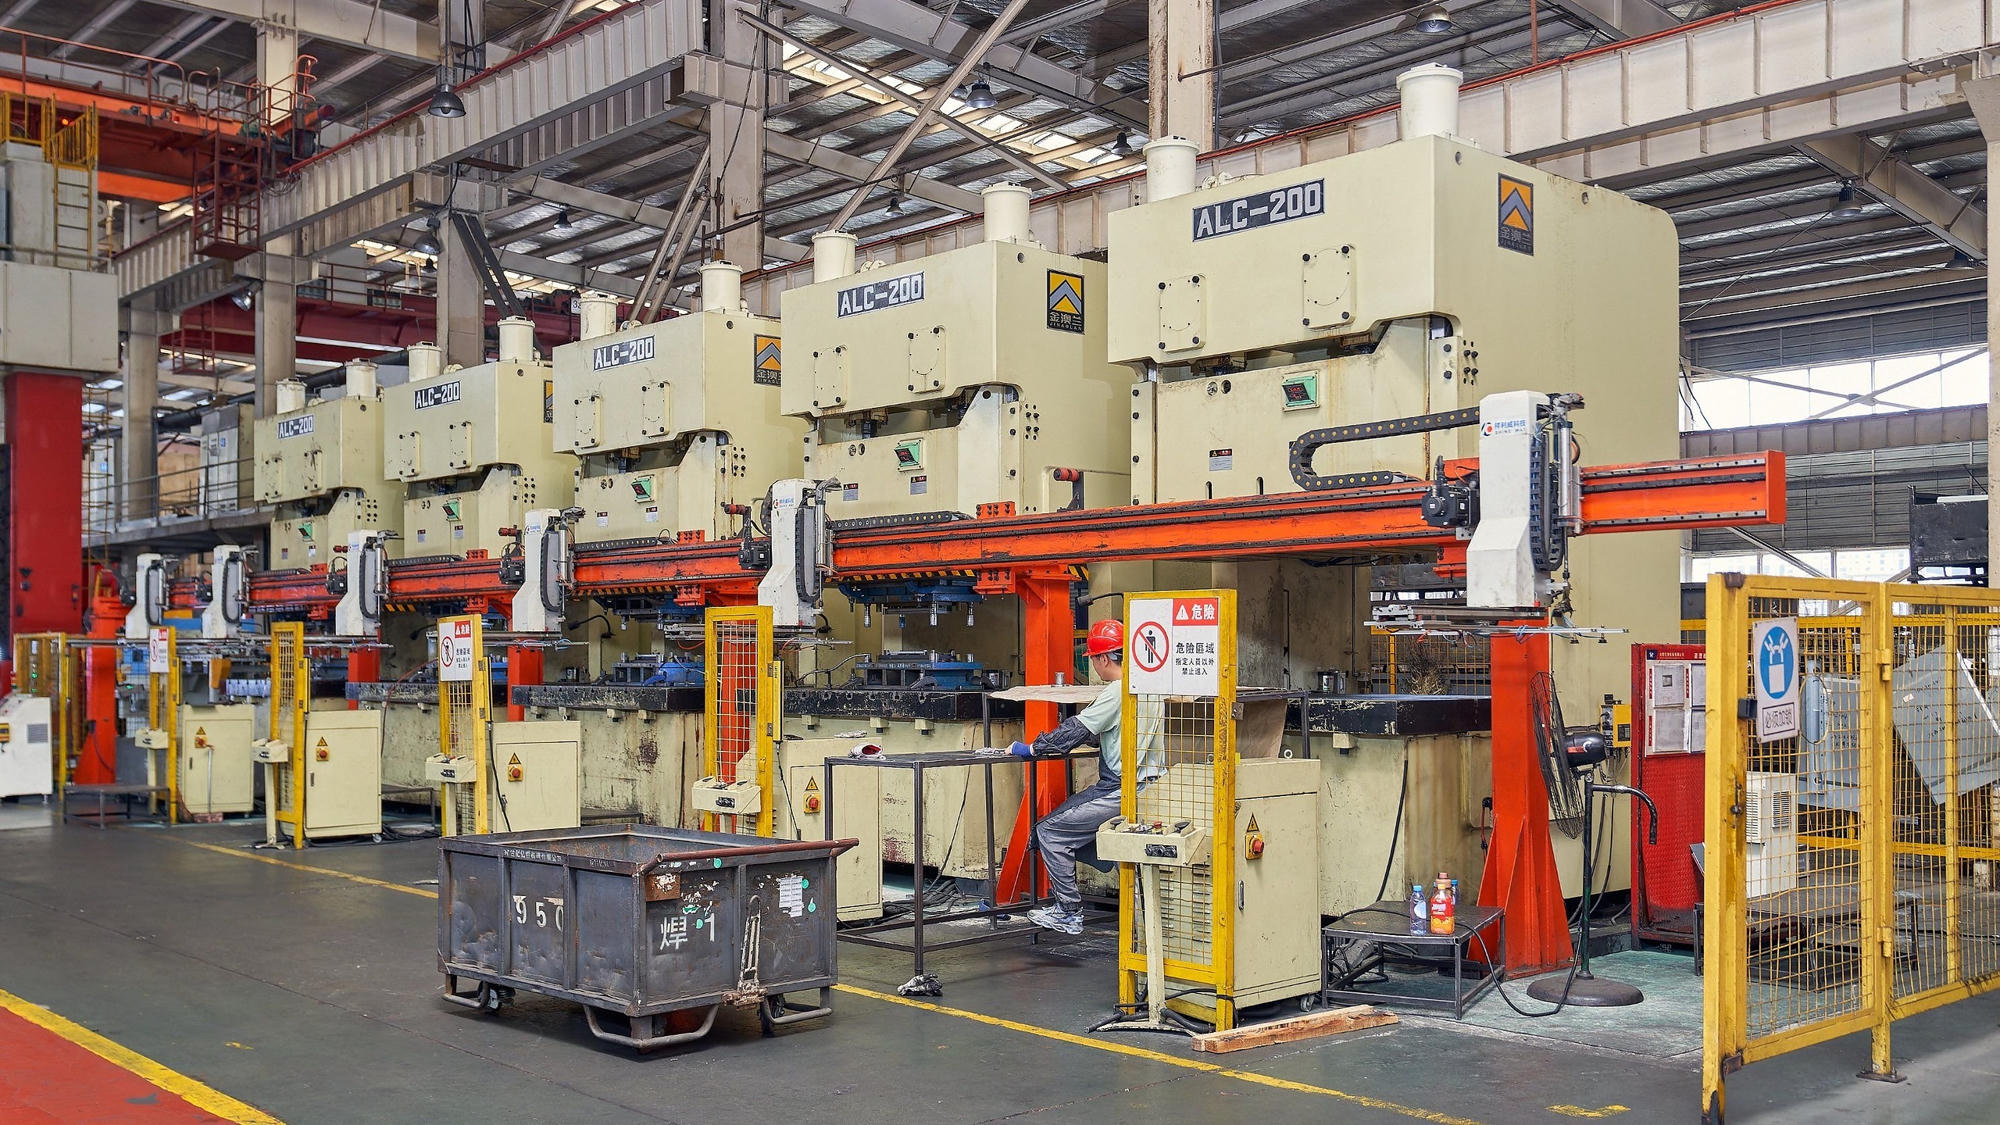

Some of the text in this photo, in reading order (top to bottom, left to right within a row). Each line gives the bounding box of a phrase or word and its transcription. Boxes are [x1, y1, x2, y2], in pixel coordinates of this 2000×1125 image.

[1196, 182, 1321, 238] ALC-200
[840, 274, 922, 315] ALC-200
[594, 338, 654, 369] ALC-200
[415, 382, 461, 409] ALC-200
[278, 416, 313, 439] ALC-200
[1191, 603, 1215, 620] 危險
[1175, 642, 1215, 654] 危險區域
[660, 916, 688, 950] 焊
